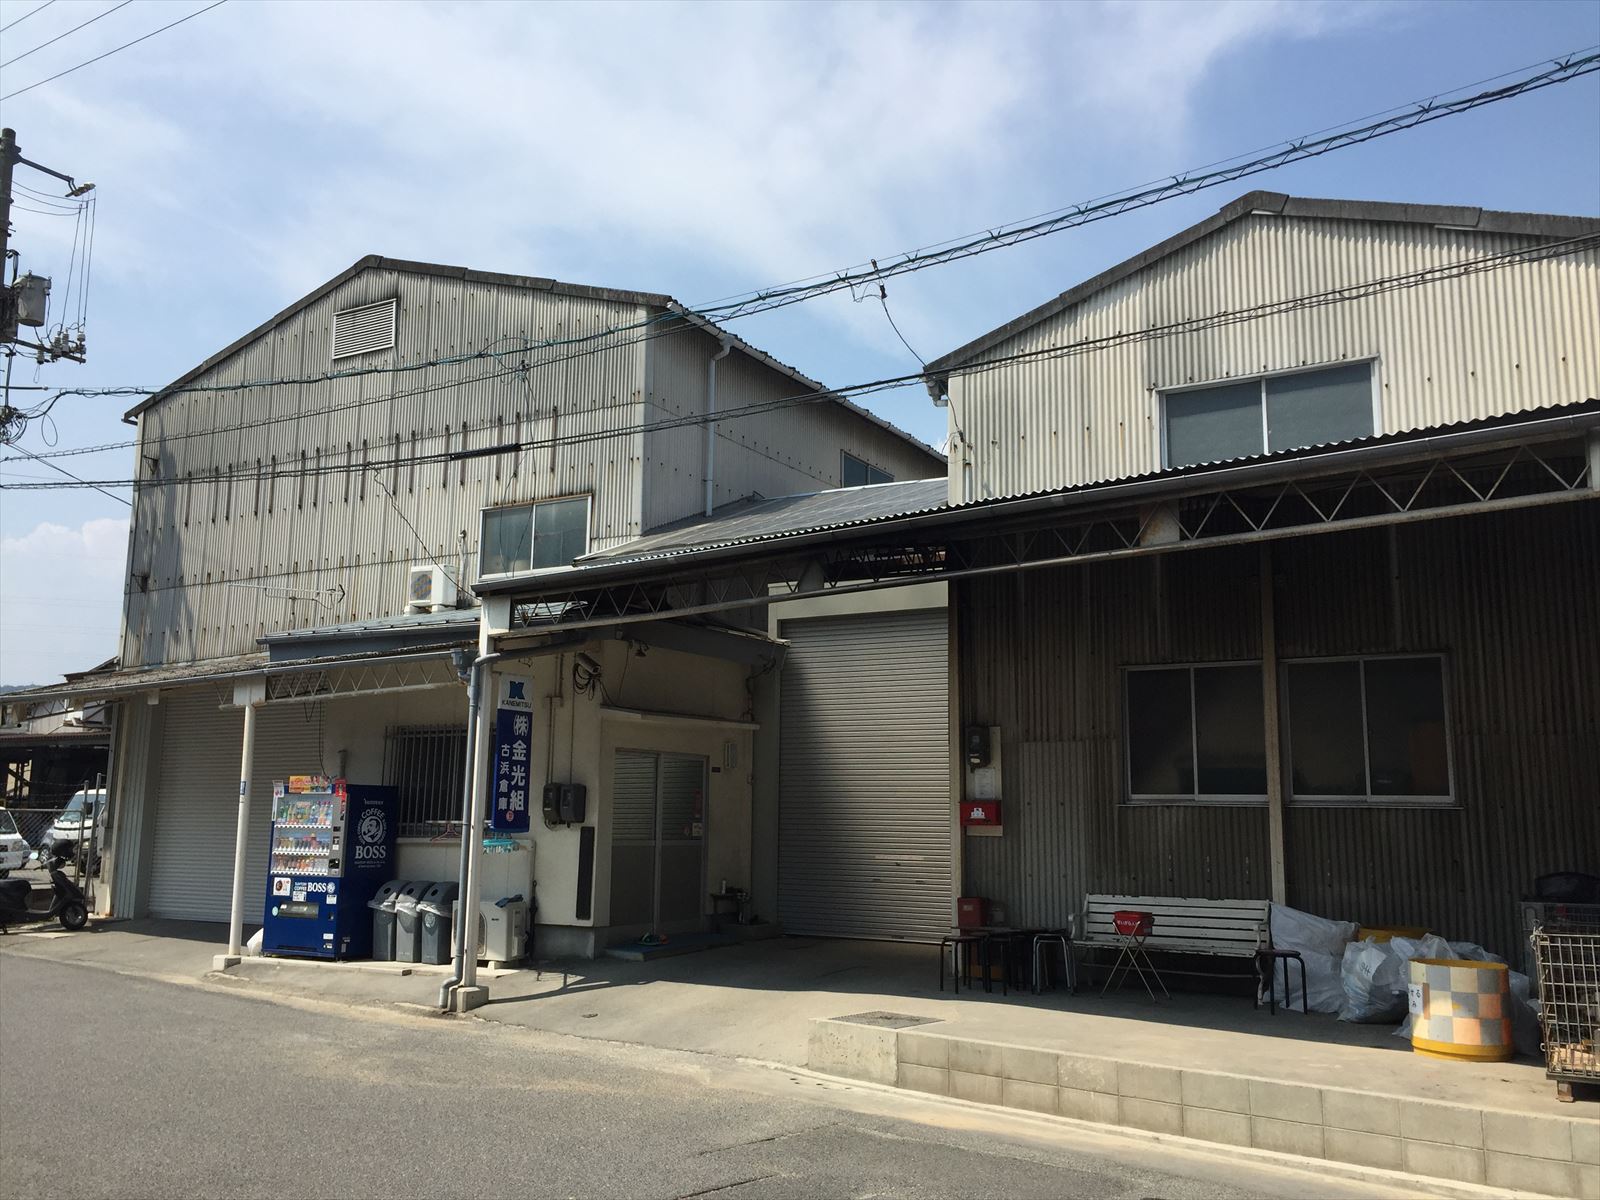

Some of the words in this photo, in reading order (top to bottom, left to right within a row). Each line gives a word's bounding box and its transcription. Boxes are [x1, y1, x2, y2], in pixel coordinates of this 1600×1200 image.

[501, 699, 532, 709] KANEMITSU
[498, 743, 511, 811] 古浜倉庫
[354, 845, 386, 859] BOSS
[307, 882, 327, 893] BOSS
